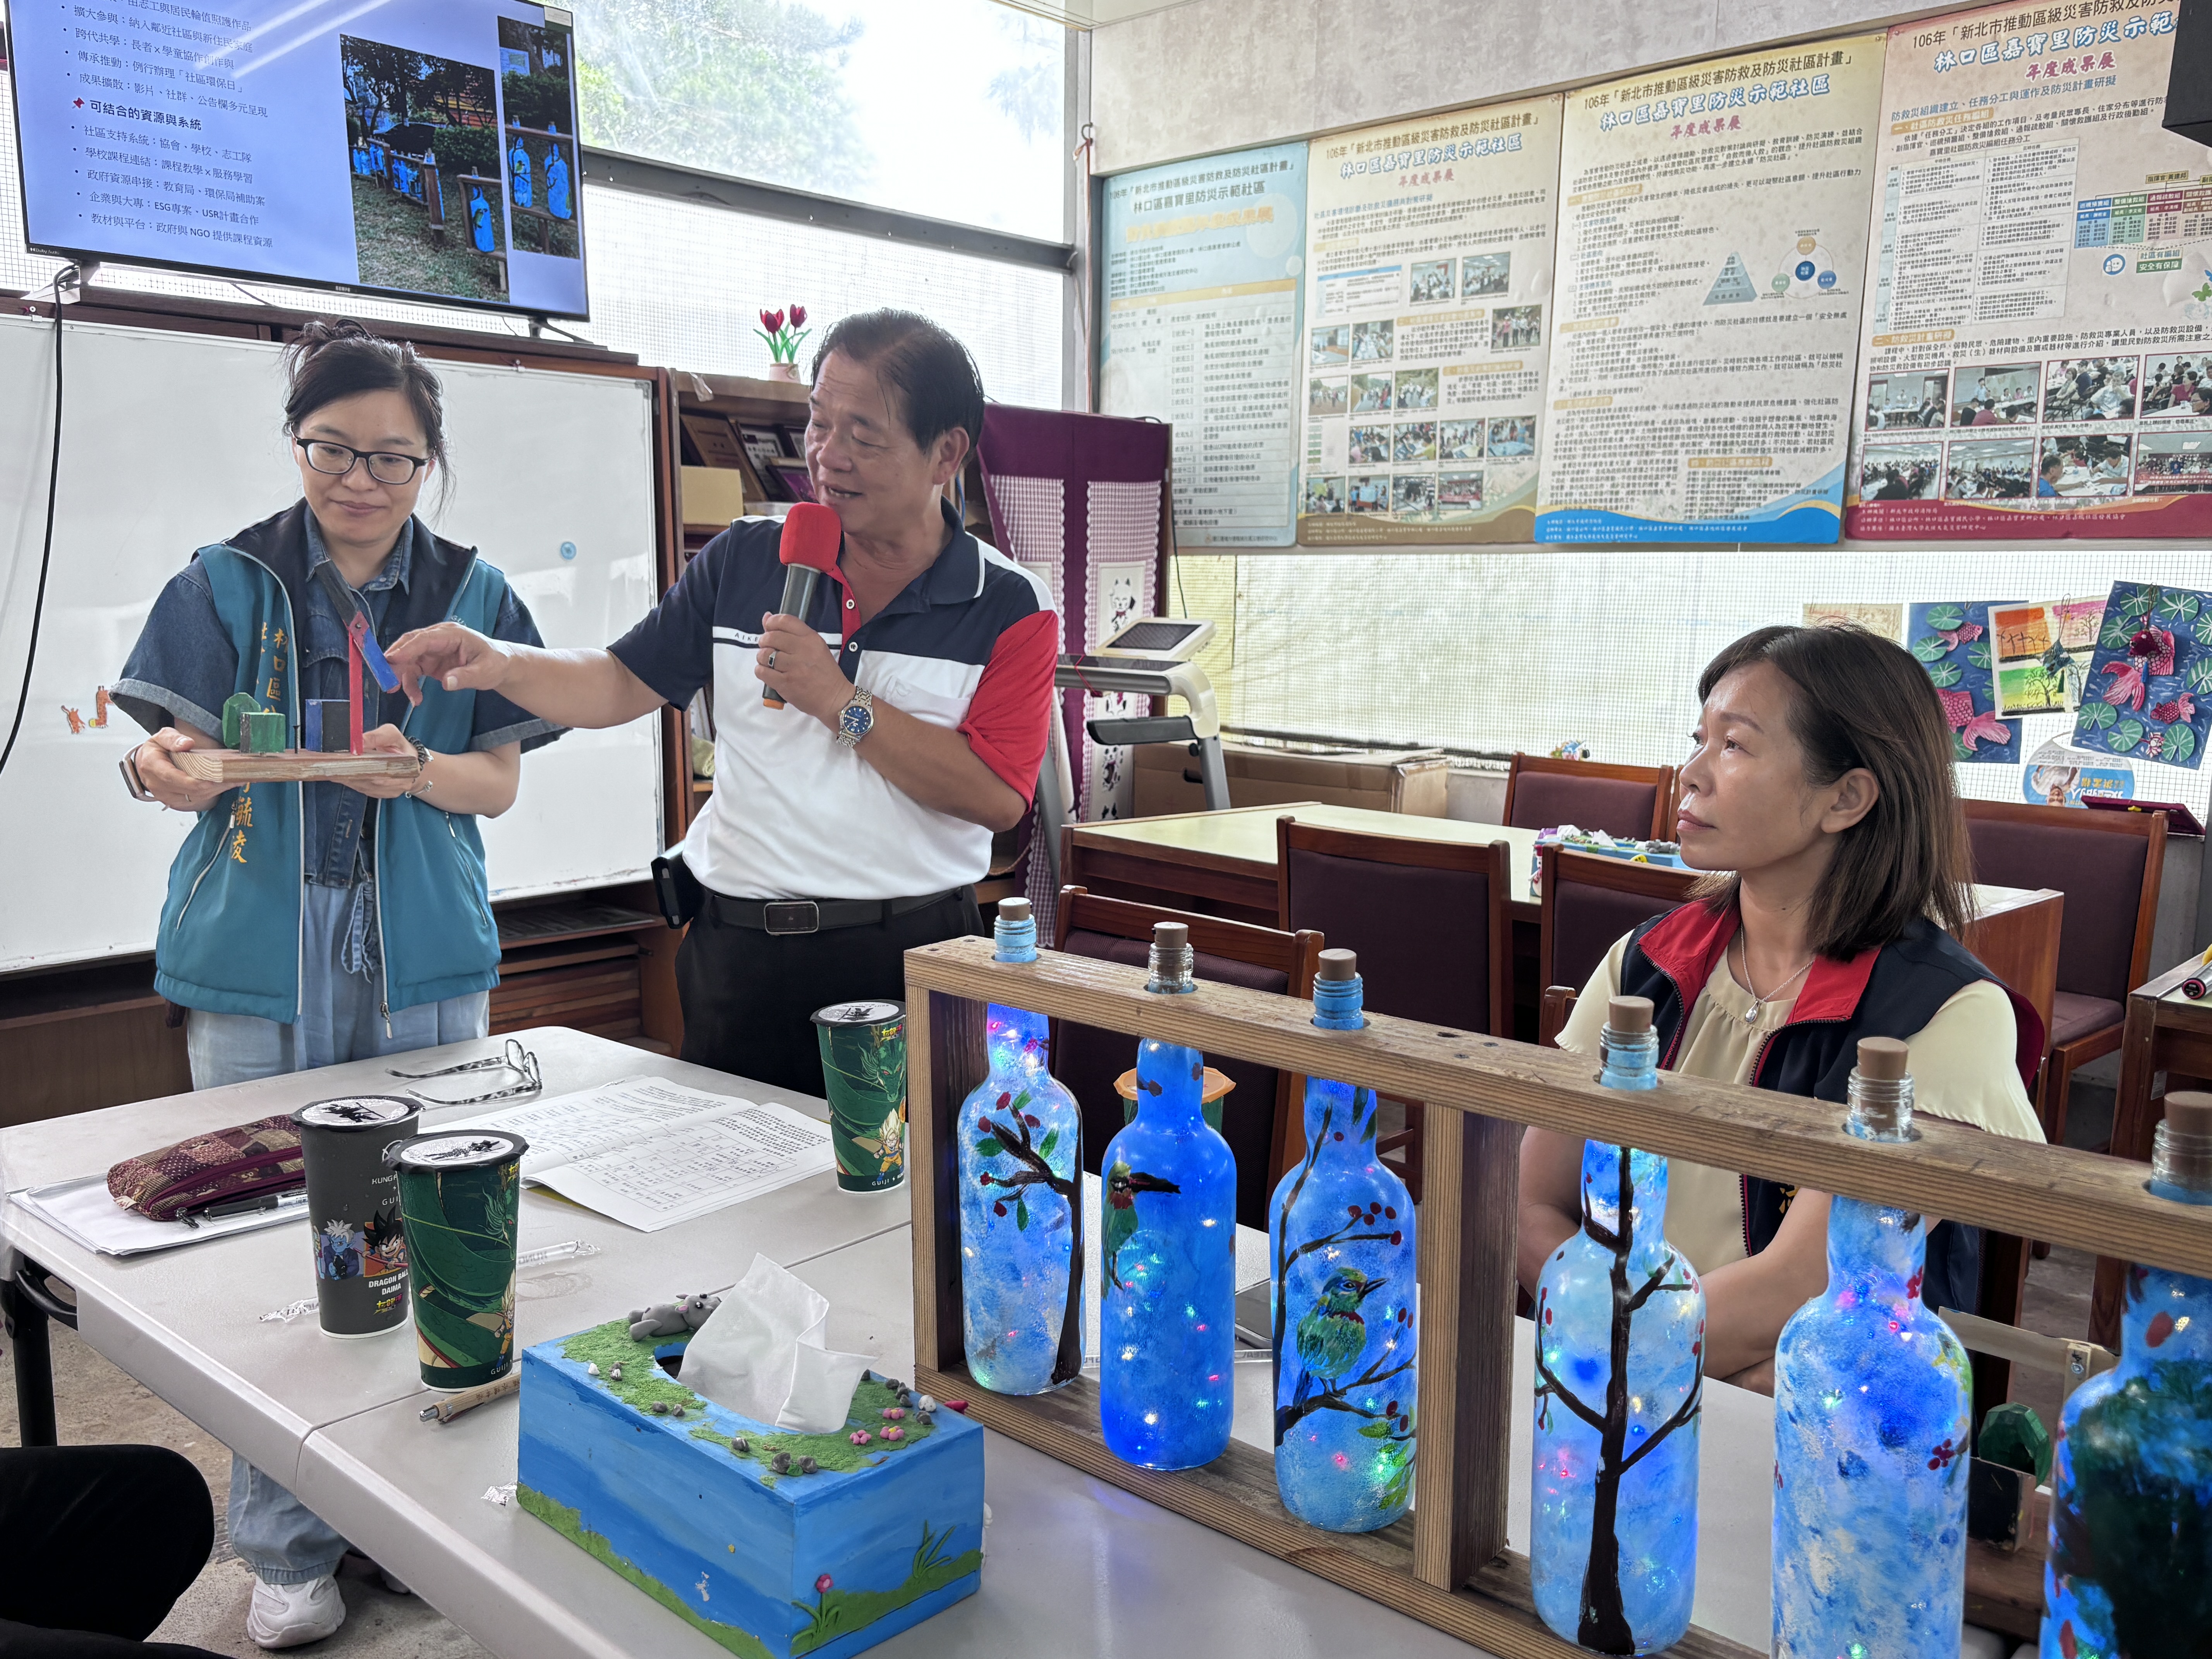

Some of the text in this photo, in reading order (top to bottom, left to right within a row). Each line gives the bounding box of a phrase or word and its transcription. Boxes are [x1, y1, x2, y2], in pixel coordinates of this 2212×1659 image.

[1935, 10, 2177, 73] 林口區嘉寶里防災示範
[78, 50, 243, 93] 傳承推動：例行辦理「社區環保日」
[1585, 50, 1852, 110] 106年「新北市推動區級災害防救及防災社區計畫」
[2025, 51, 2116, 81] 年度成果展
[80, 73, 268, 118] 成果擴散：影片、社群、公告欄多元呈現
[1600, 73, 1830, 132] 林口區嘉寶里防災示範社區
[90, 100, 201, 131] 可結合的資源與系統
[1670, 115, 1742, 140] 年度成果展
[84, 125, 252, 163] 社區支持系統：協會、學校、志工隊
[1326, 113, 1539, 159] 106年「新北市推動區級災害防救及防災社區計畫」
[1340, 133, 1523, 179] 林口區嘉寶里防災示範社區
[88, 169, 265, 207] 政府資源串接：教育局、環保局補助案
[213, 168, 252, 184] 服務學習
[1398, 168, 1455, 187] 年度成果展
[1133, 180, 1265, 214] 林口區嘉寶里防災示範社區
[191, 228, 210, 238] NGO
[213, 231, 272, 248] 提供課程資源
[2140, 261, 2179, 271] 安全有保障
[368, 1275, 397, 1288] DRAGON
[382, 1283, 401, 1295] DAIMA
